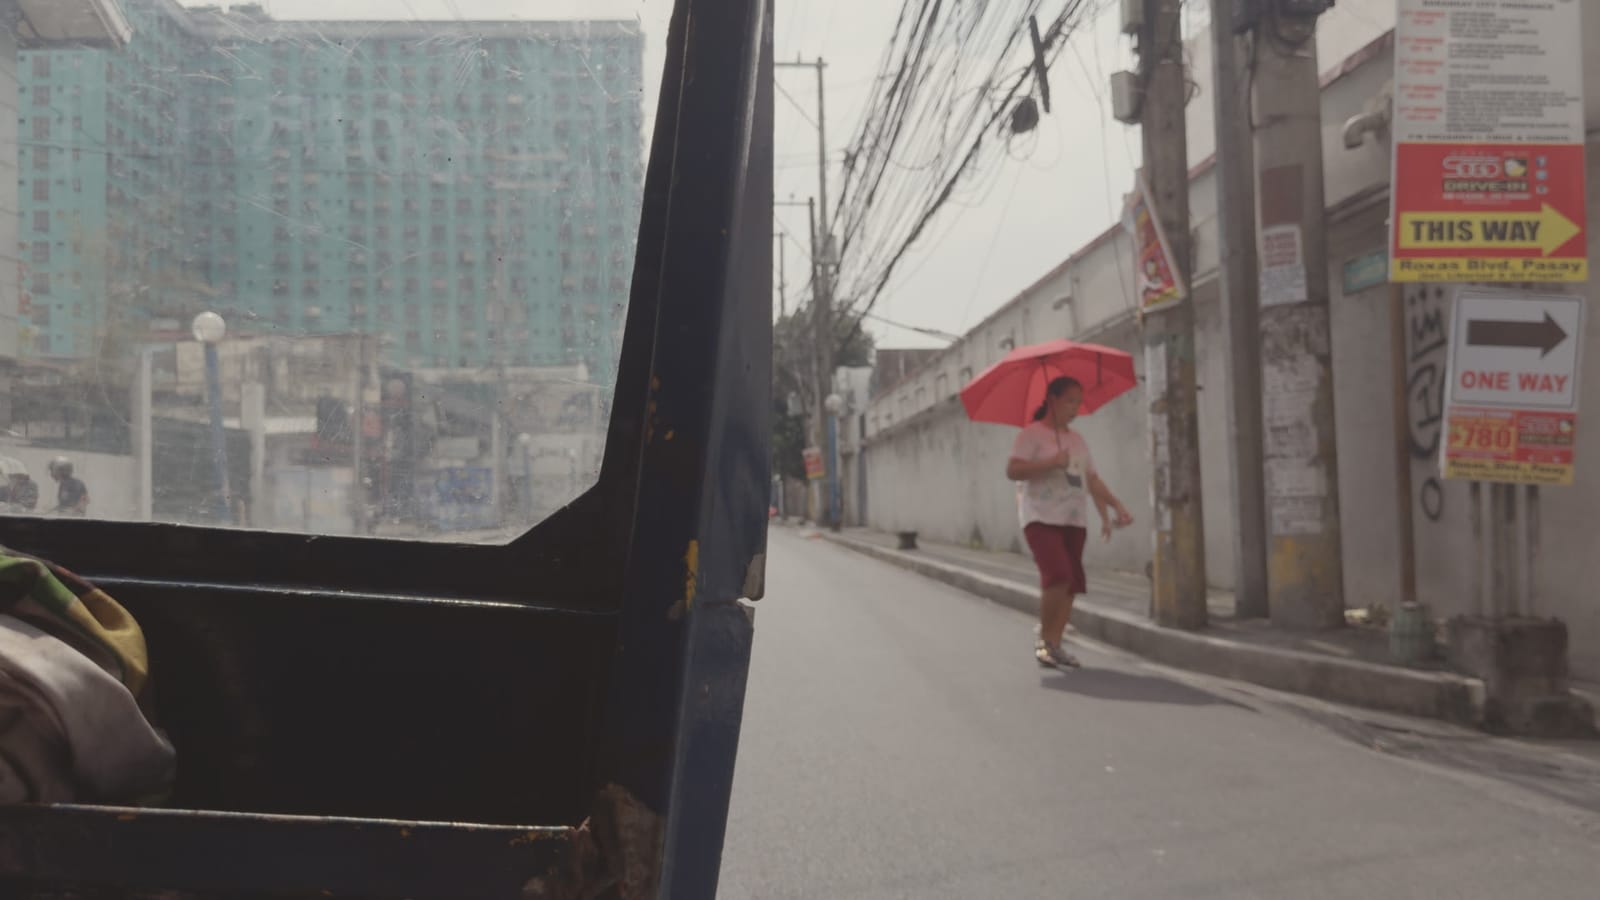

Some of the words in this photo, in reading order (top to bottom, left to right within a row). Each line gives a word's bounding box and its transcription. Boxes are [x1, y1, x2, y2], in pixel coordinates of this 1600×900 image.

[1443, 180, 1528, 193] DRIVE-IN
[1411, 220, 1474, 241] THIS
[1481, 220, 1541, 241] WAY
[1400, 260, 1460, 272] Roxas
[1523, 260, 1582, 273] Pasay
[1460, 370, 1510, 391] ONE
[1517, 373, 1568, 393] WAY
